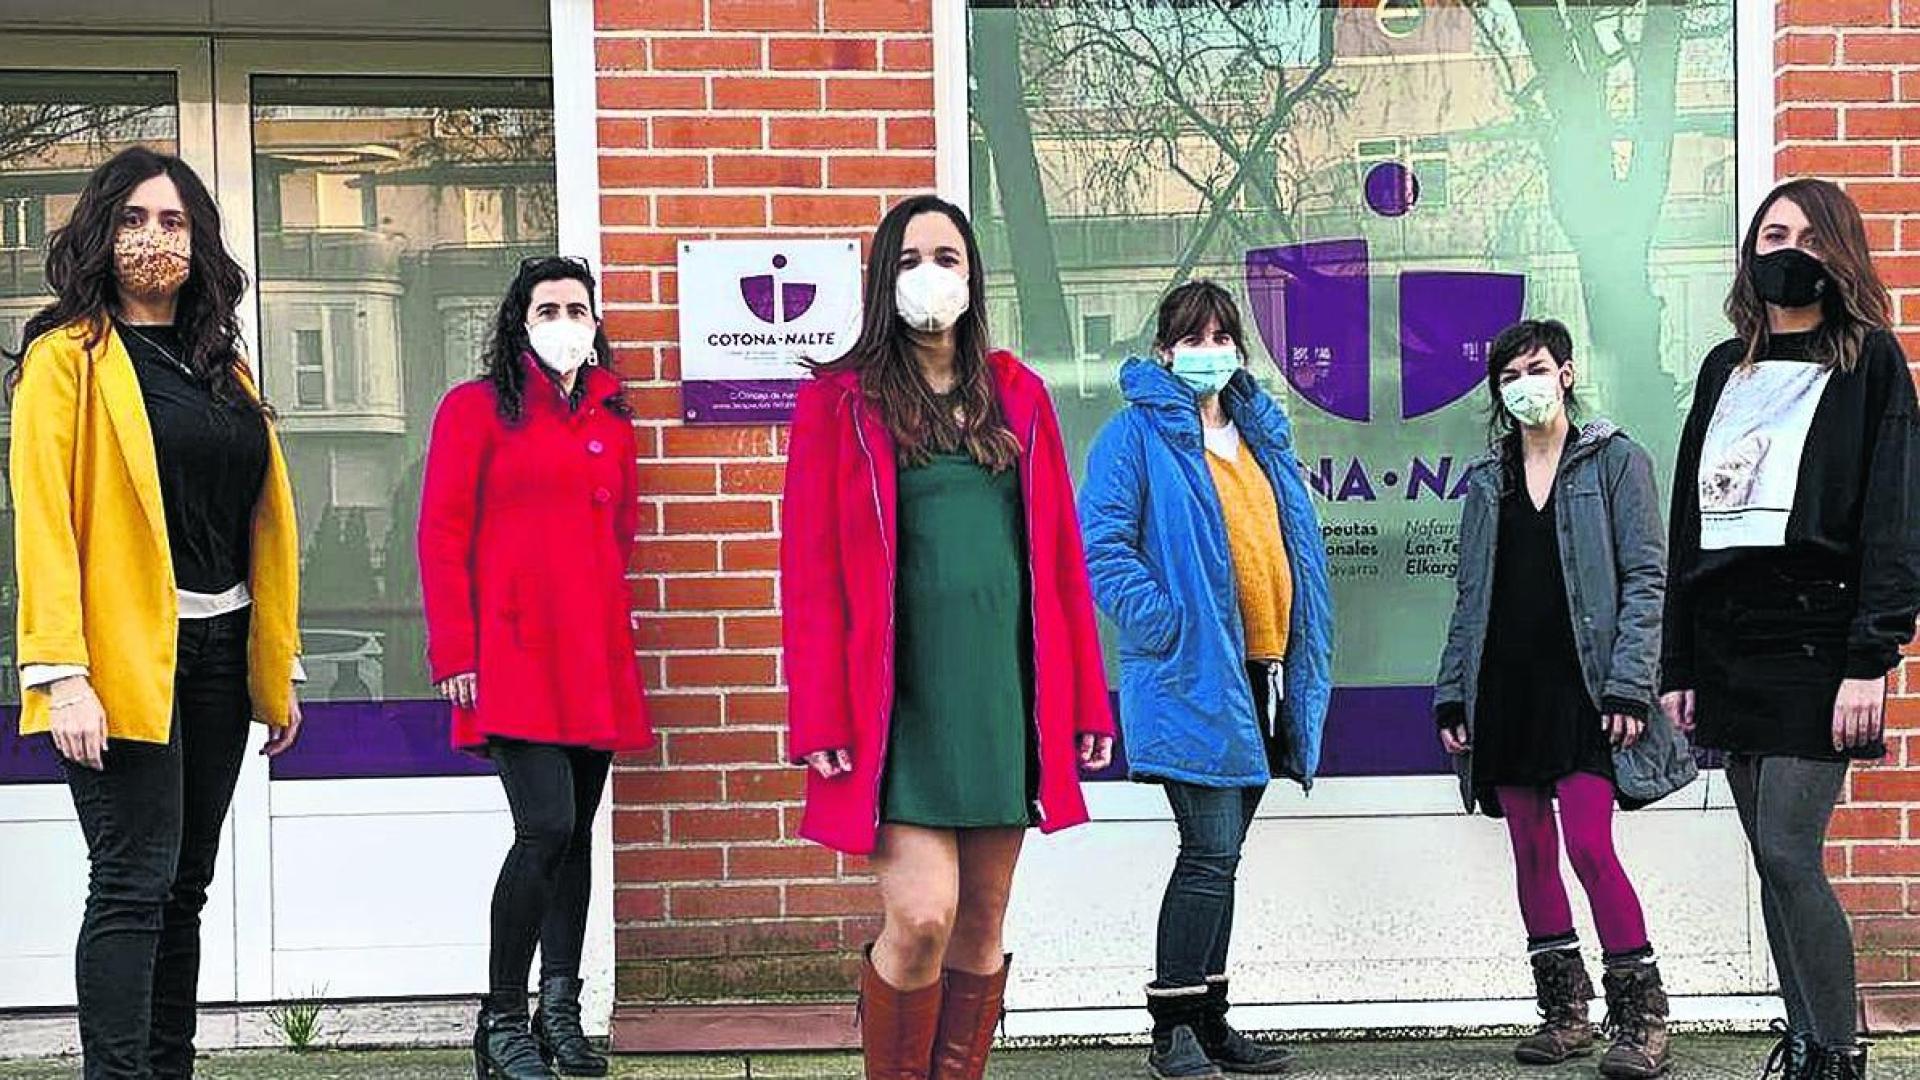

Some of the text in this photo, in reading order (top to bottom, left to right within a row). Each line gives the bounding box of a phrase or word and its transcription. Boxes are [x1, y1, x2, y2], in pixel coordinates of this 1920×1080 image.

[1318, 522, 1377, 540] peutas
[1325, 539, 1378, 556] onales
[1406, 559, 1458, 578] Elkarg
